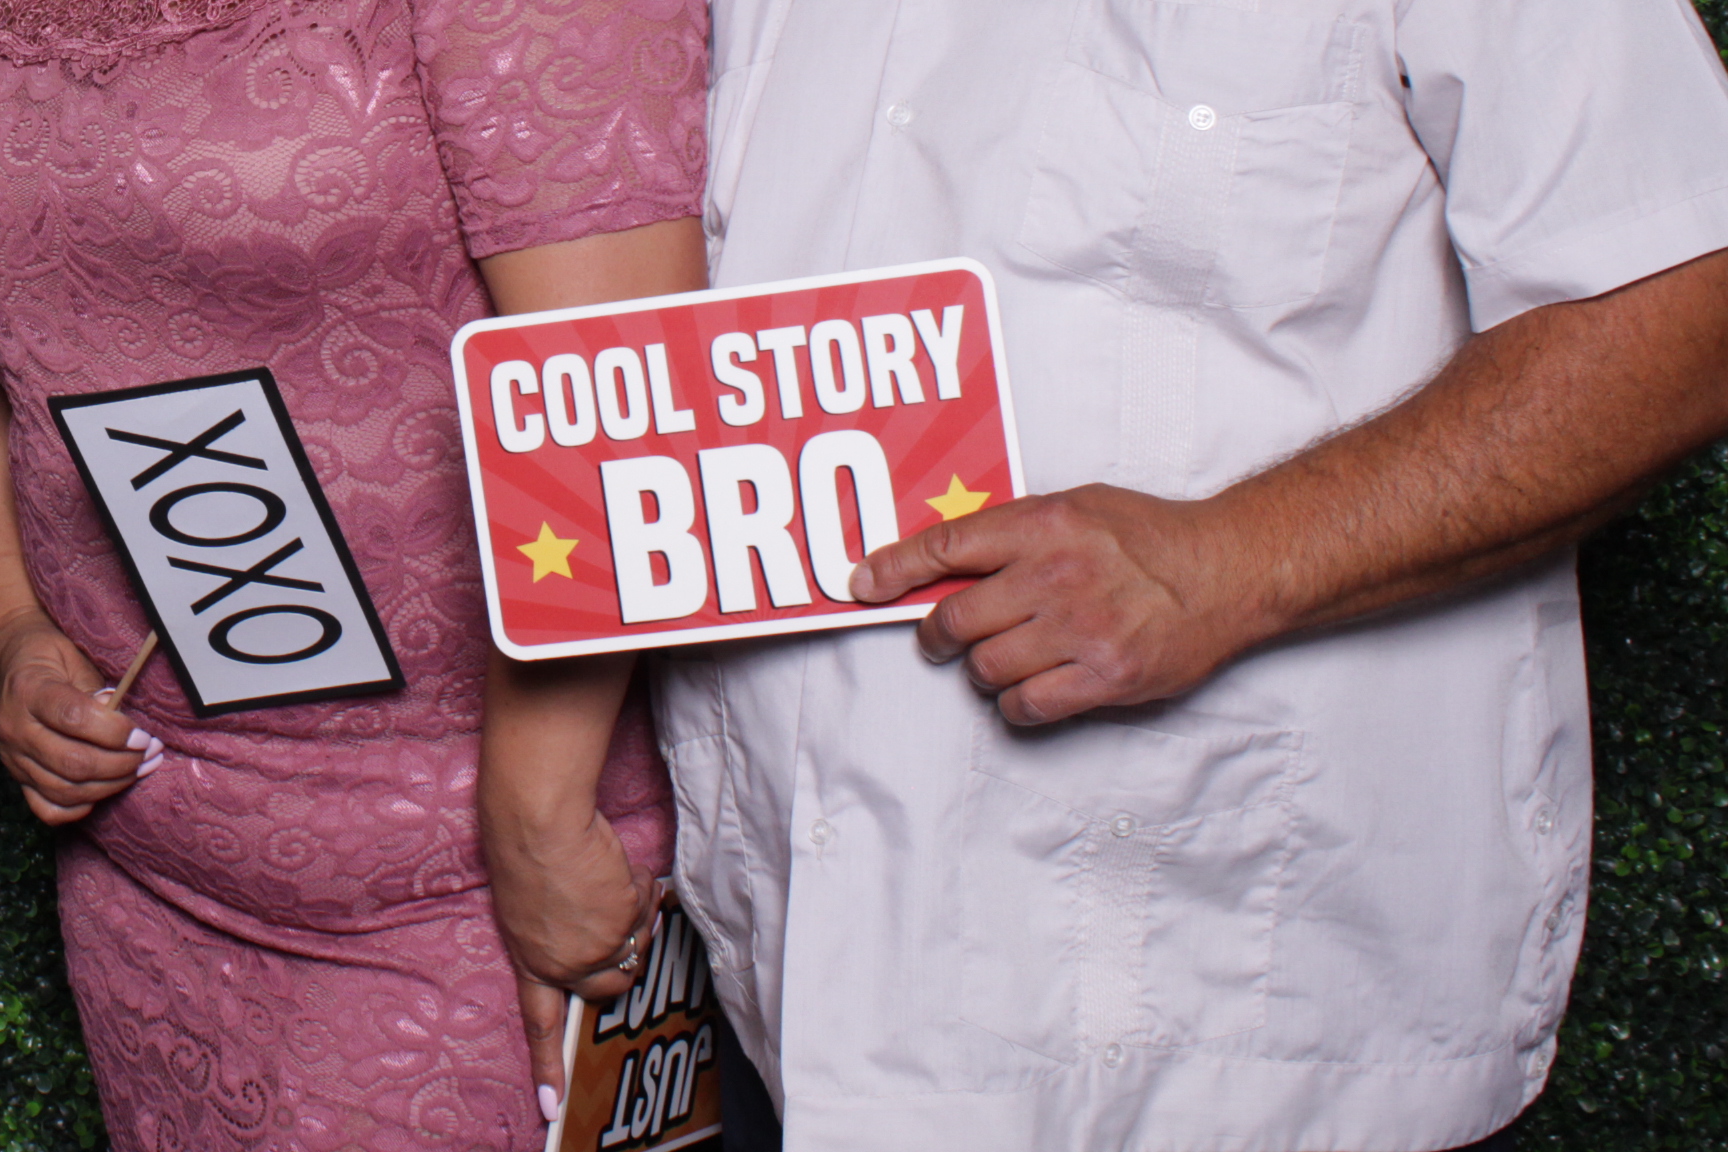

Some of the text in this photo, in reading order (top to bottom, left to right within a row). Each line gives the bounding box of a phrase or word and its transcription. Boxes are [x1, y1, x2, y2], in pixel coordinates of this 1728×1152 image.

[490, 304, 965, 453] COOL STORY
[104, 408, 343, 665] XOXO
[599, 429, 900, 625] BRO
[601, 1023, 713, 1148] JUST
